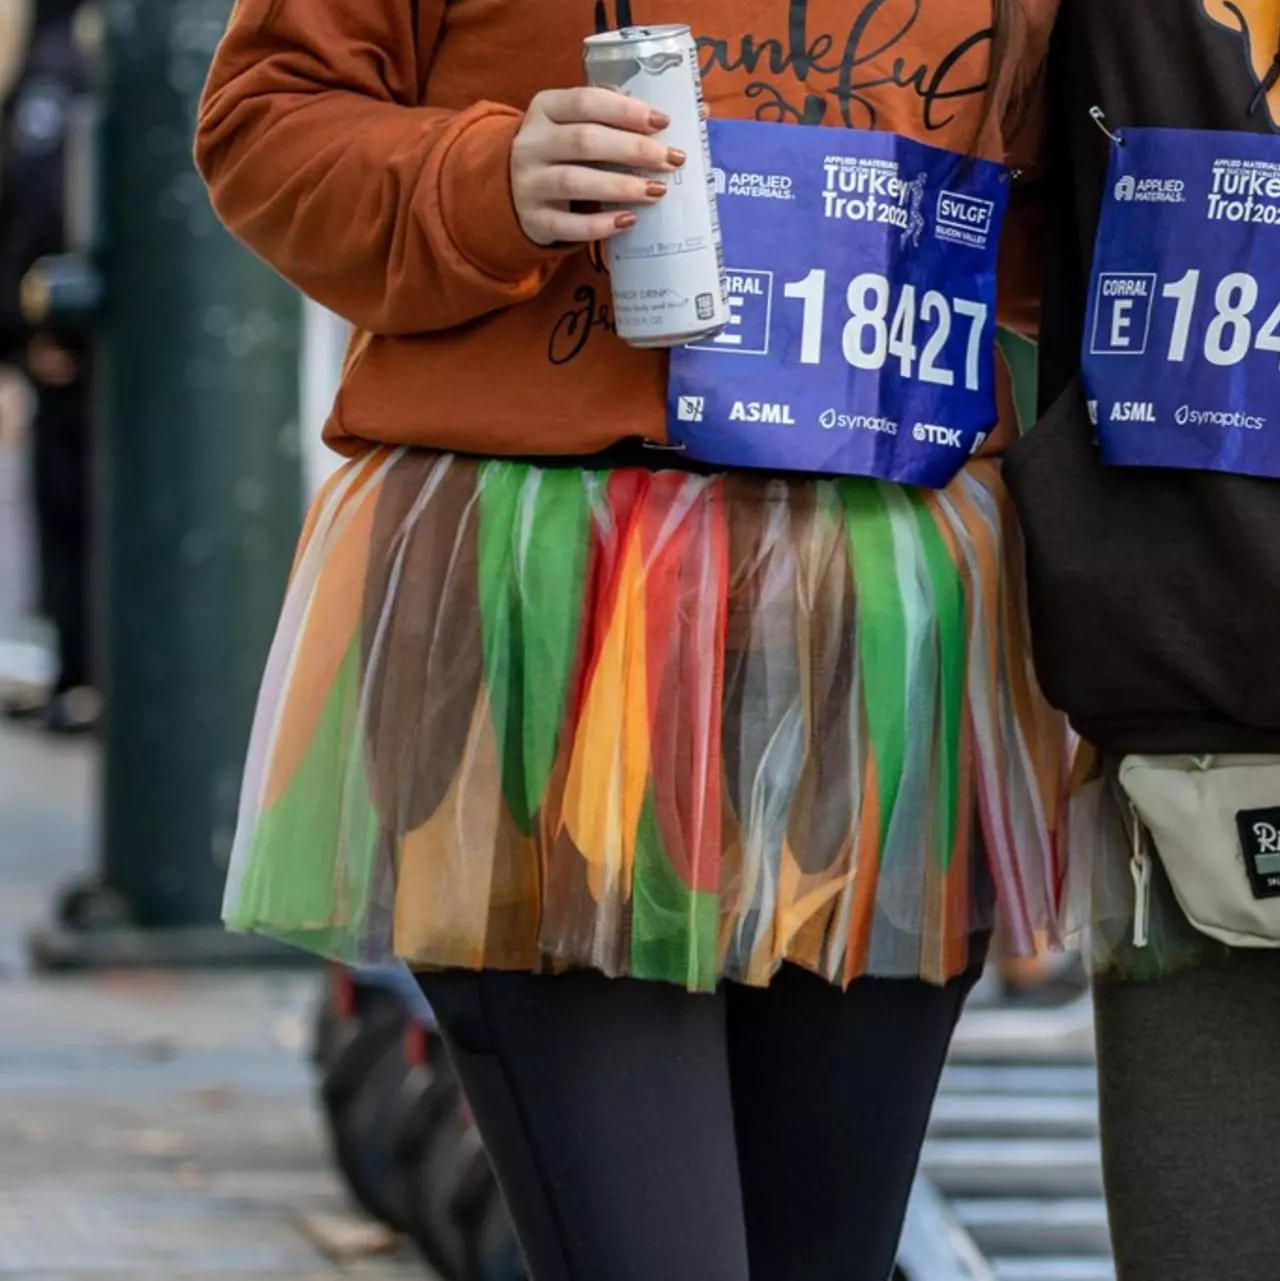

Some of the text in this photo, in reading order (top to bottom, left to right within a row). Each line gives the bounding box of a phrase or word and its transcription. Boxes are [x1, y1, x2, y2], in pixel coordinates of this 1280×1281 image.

[728, 186, 791, 199] MATERIALS
[729, 172, 792, 189] APPLIED
[824, 165, 908, 205] Turkey
[1136, 179, 1185, 192] APPLIED
[823, 190, 908, 228] Trot 2022
[942, 199, 987, 224] SVLGF
[1207, 194, 1253, 222] Trot
[1102, 280, 1149, 297] CORRAL
[783, 268, 988, 391] 18427
[1110, 299, 1133, 348] E
[729, 401, 796, 425] ASML
[1110, 401, 1156, 422] ASML
[926, 423, 964, 449] TDK
